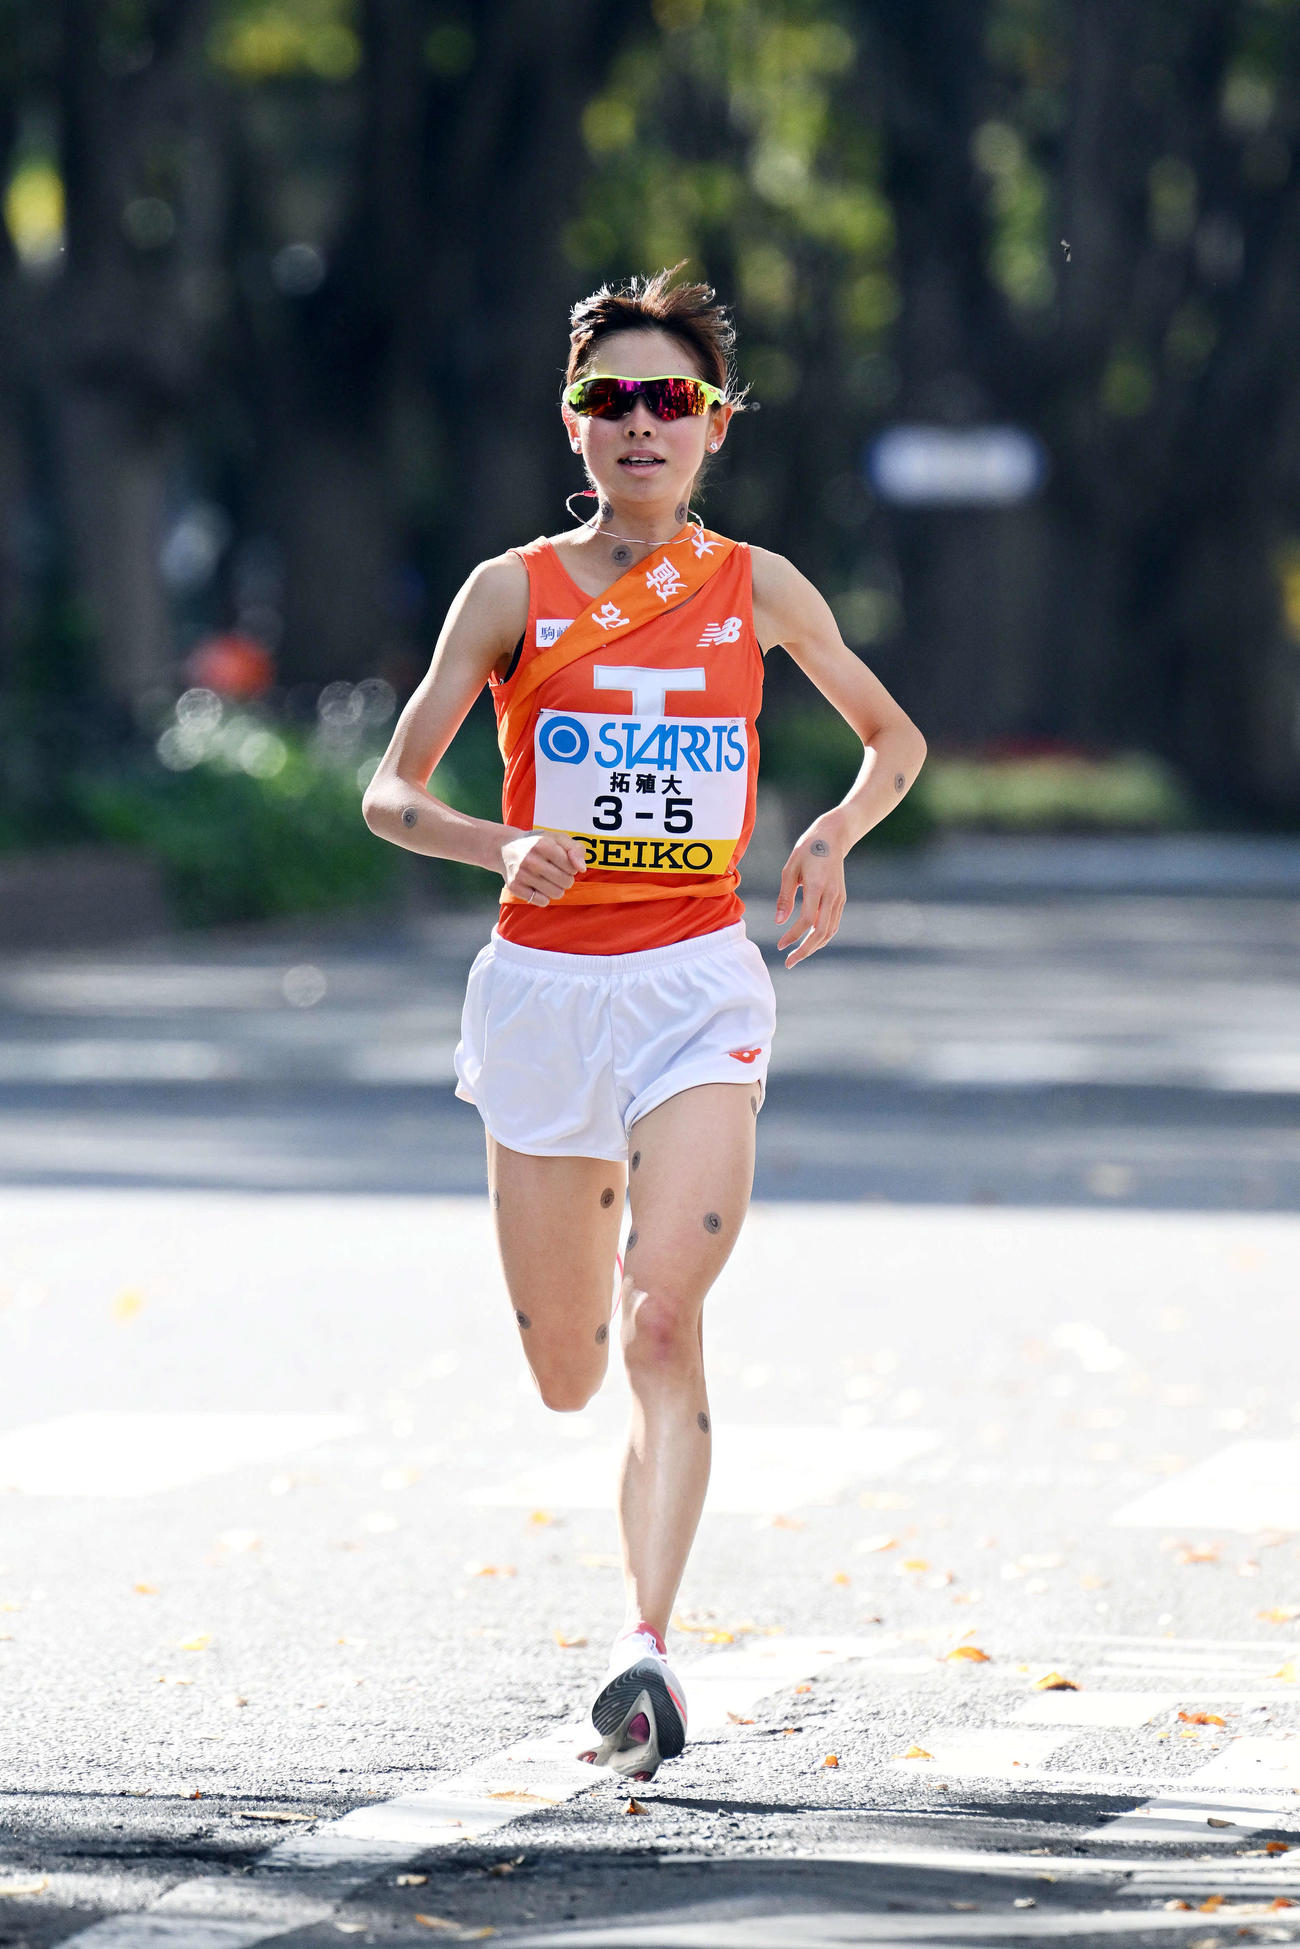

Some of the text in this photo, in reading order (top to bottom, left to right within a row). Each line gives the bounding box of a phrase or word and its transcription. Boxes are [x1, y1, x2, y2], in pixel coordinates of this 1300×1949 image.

[610, 772, 682, 795] 拓殖大
[592, 795, 694, 834] 3-5
[572, 836, 713, 870] SEIKO
